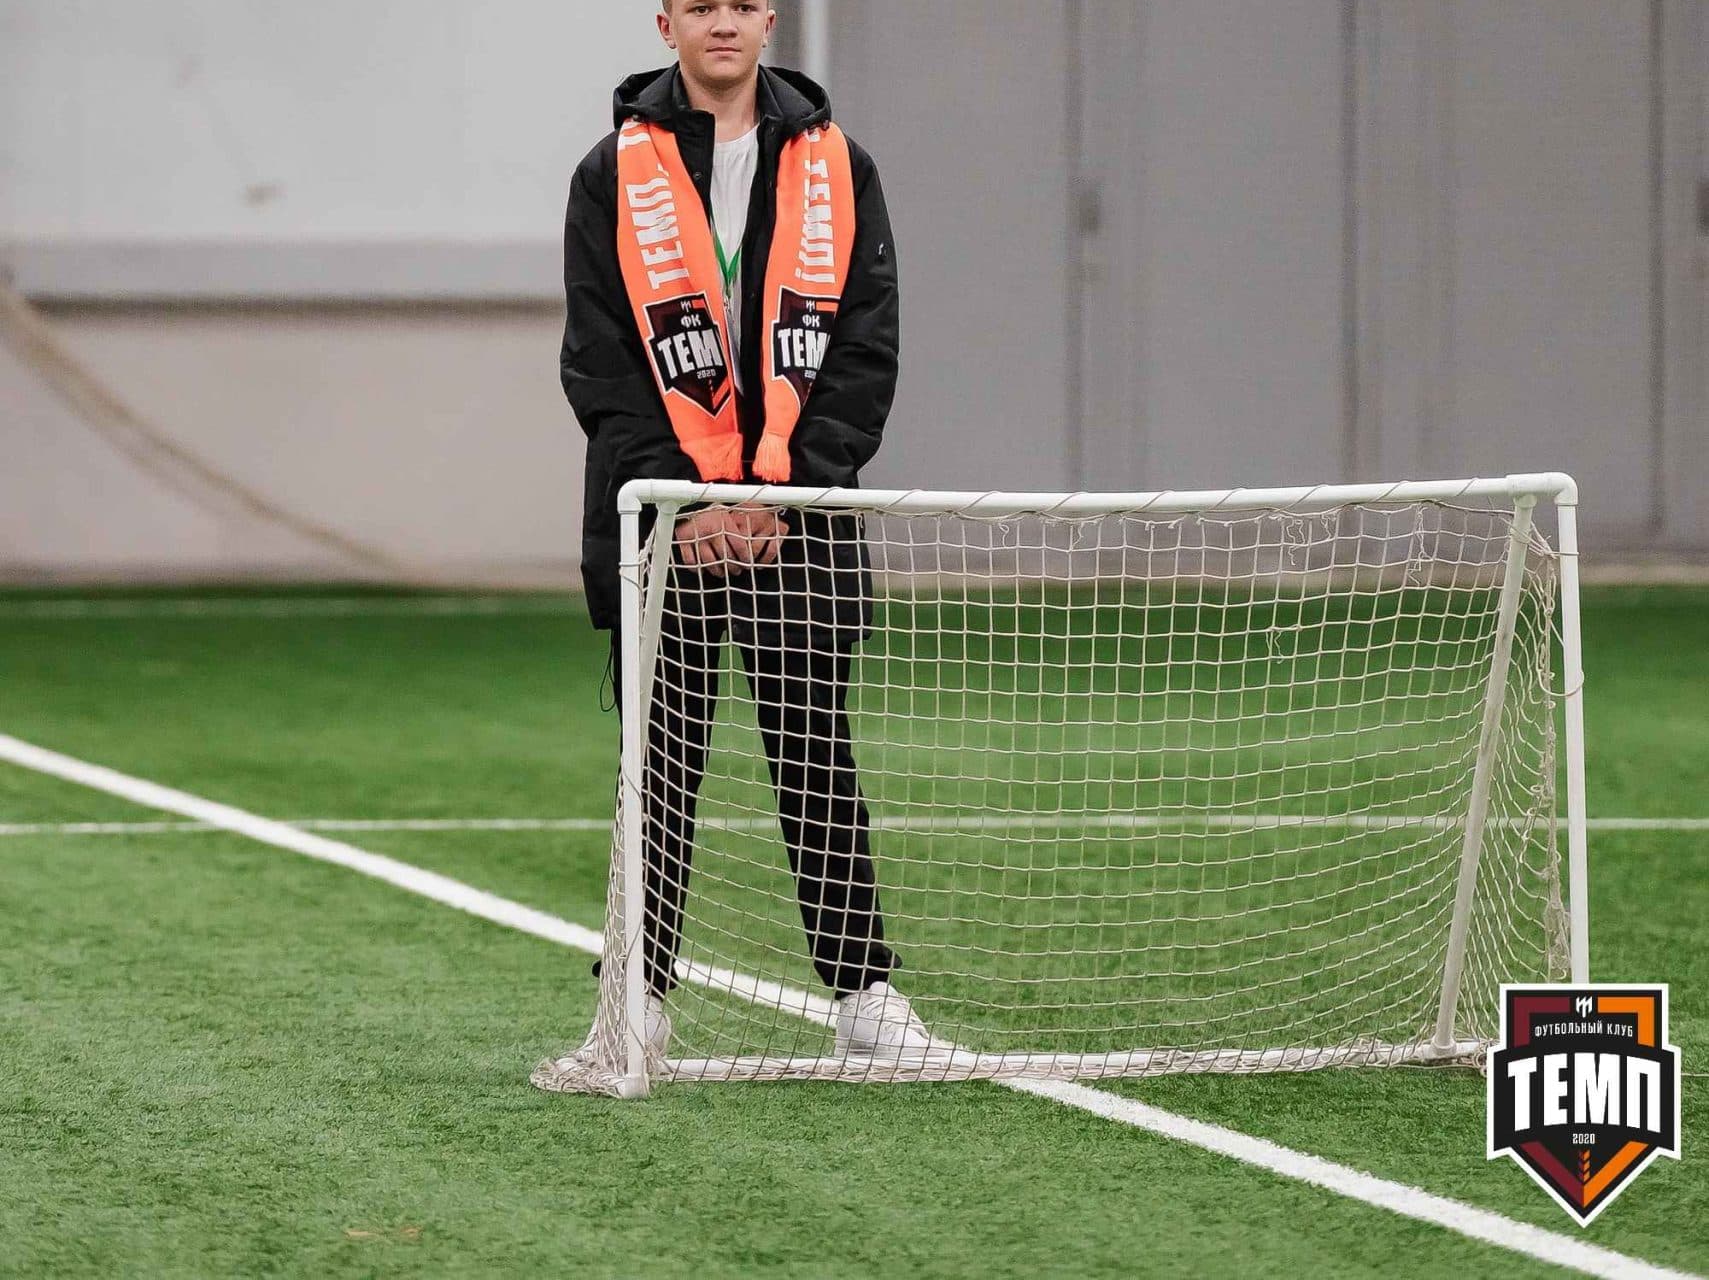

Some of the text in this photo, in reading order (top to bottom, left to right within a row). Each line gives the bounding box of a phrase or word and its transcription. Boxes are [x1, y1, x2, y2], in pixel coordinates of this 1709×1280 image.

[680, 313, 702, 328] ФК
[801, 313, 821, 328] ФК
[657, 328, 724, 380] ТЕМ
[777, 327, 831, 370] ТЕМ
[696, 368, 717, 380] 2020
